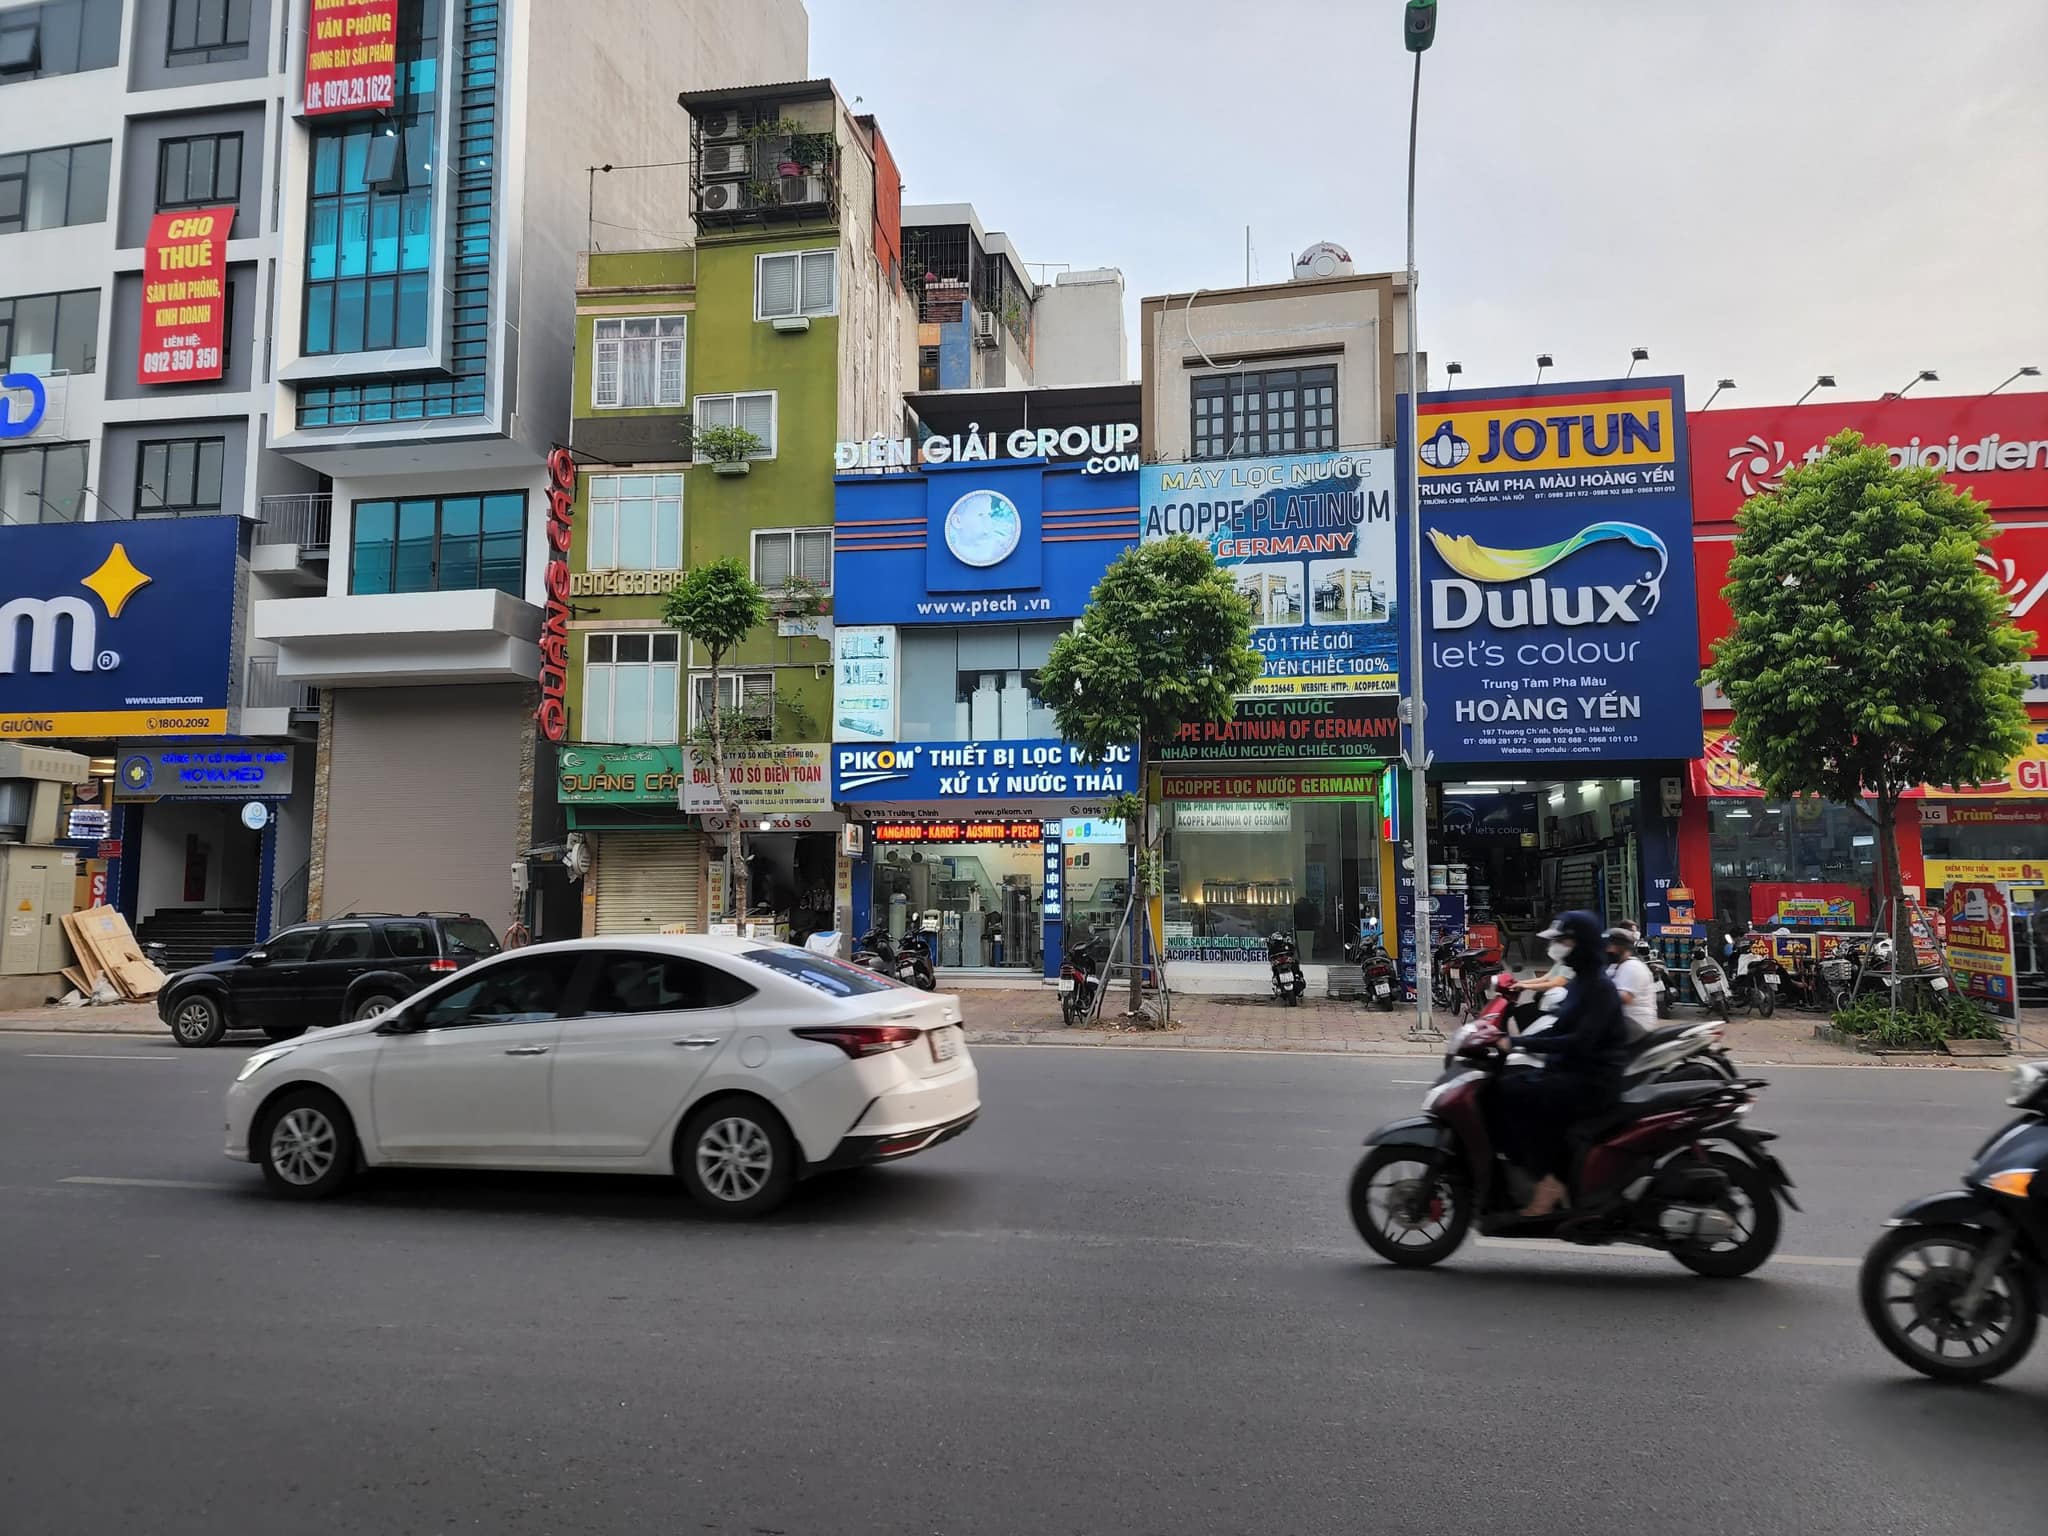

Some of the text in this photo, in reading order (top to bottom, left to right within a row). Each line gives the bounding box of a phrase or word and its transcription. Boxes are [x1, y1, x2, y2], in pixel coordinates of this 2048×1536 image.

[317, 11, 392, 40] VĂN PHÒNG
[323, 74, 392, 108] 0979.29.1622
[168, 216, 214, 240] CHO
[158, 239, 213, 271] THUÊ
[155, 305, 211, 327] KINH DOANH
[143, 347, 217, 373] 0912 350 350
[922, 422, 996, 464] GIẢI
[1006, 422, 1139, 459] GROUP
[1478, 410, 1661, 464] JOTUN
[1081, 453, 1139, 475] .COM
[1160, 456, 1372, 491] MÁY LỌC NƯỚC
[1466, 465, 1675, 493] TÂM PHA MÀU HOÀNG YẾN
[1145, 489, 1391, 537] ACOPPE PLATINUM
[1217, 532, 1354, 558] GERMANY
[917, 595, 1018, 616] www.ptech
[1431, 577, 1641, 630] Dulux
[1258, 631, 1277, 652] SỐ
[1280, 637, 1287, 651] 1
[1290, 630, 1319, 650] THẾ
[1302, 653, 1389, 675] CHIẾC 100%
[1433, 637, 1641, 669] let's colour
[1481, 675, 1607, 691] Trung Tâm Pha Màu
[125, 694, 203, 705] www.vuanem.com
[1244, 702, 1278, 718] LỌC
[1283, 698, 1335, 715] NƯỚC
[1455, 689, 1641, 722] HOÀNG YẾN
[1, 717, 210, 733] GIƯỜNG 1800.2092
[1205, 717, 1397, 741] PLATINUM OF GERMANY
[1482, 728, 1495, 736] 197
[1161, 739, 1376, 761] NHẬP KHẨU NGUYÊN CHIẾC 100%
[1553, 736, 1566, 744] 102
[840, 750, 914, 770] PIKOM
[929, 743, 987, 767] THIẾT
[993, 748, 1015, 769] BỊ
[1022, 747, 1062, 768] LỌC
[562, 763, 637, 793] QUẢNG
[939, 767, 1123, 794] XỬ LÝ NƯỚC THẢI
[1166, 775, 1373, 797] ACOPPE LỌC NƯỚC GERMANY
[1178, 815, 1205, 826] ACOPPE
[1254, 815, 1288, 826] GERMANY
[1925, 811, 1941, 820] LG
[876, 826, 922, 840] KANGAROO
[928, 825, 960, 839] KAROFI
[1011, 824, 1040, 837] PTECH
[1045, 823, 1059, 835] 193
[1654, 879, 1671, 888] 197
[1166, 949, 1200, 961] ACOPPE
